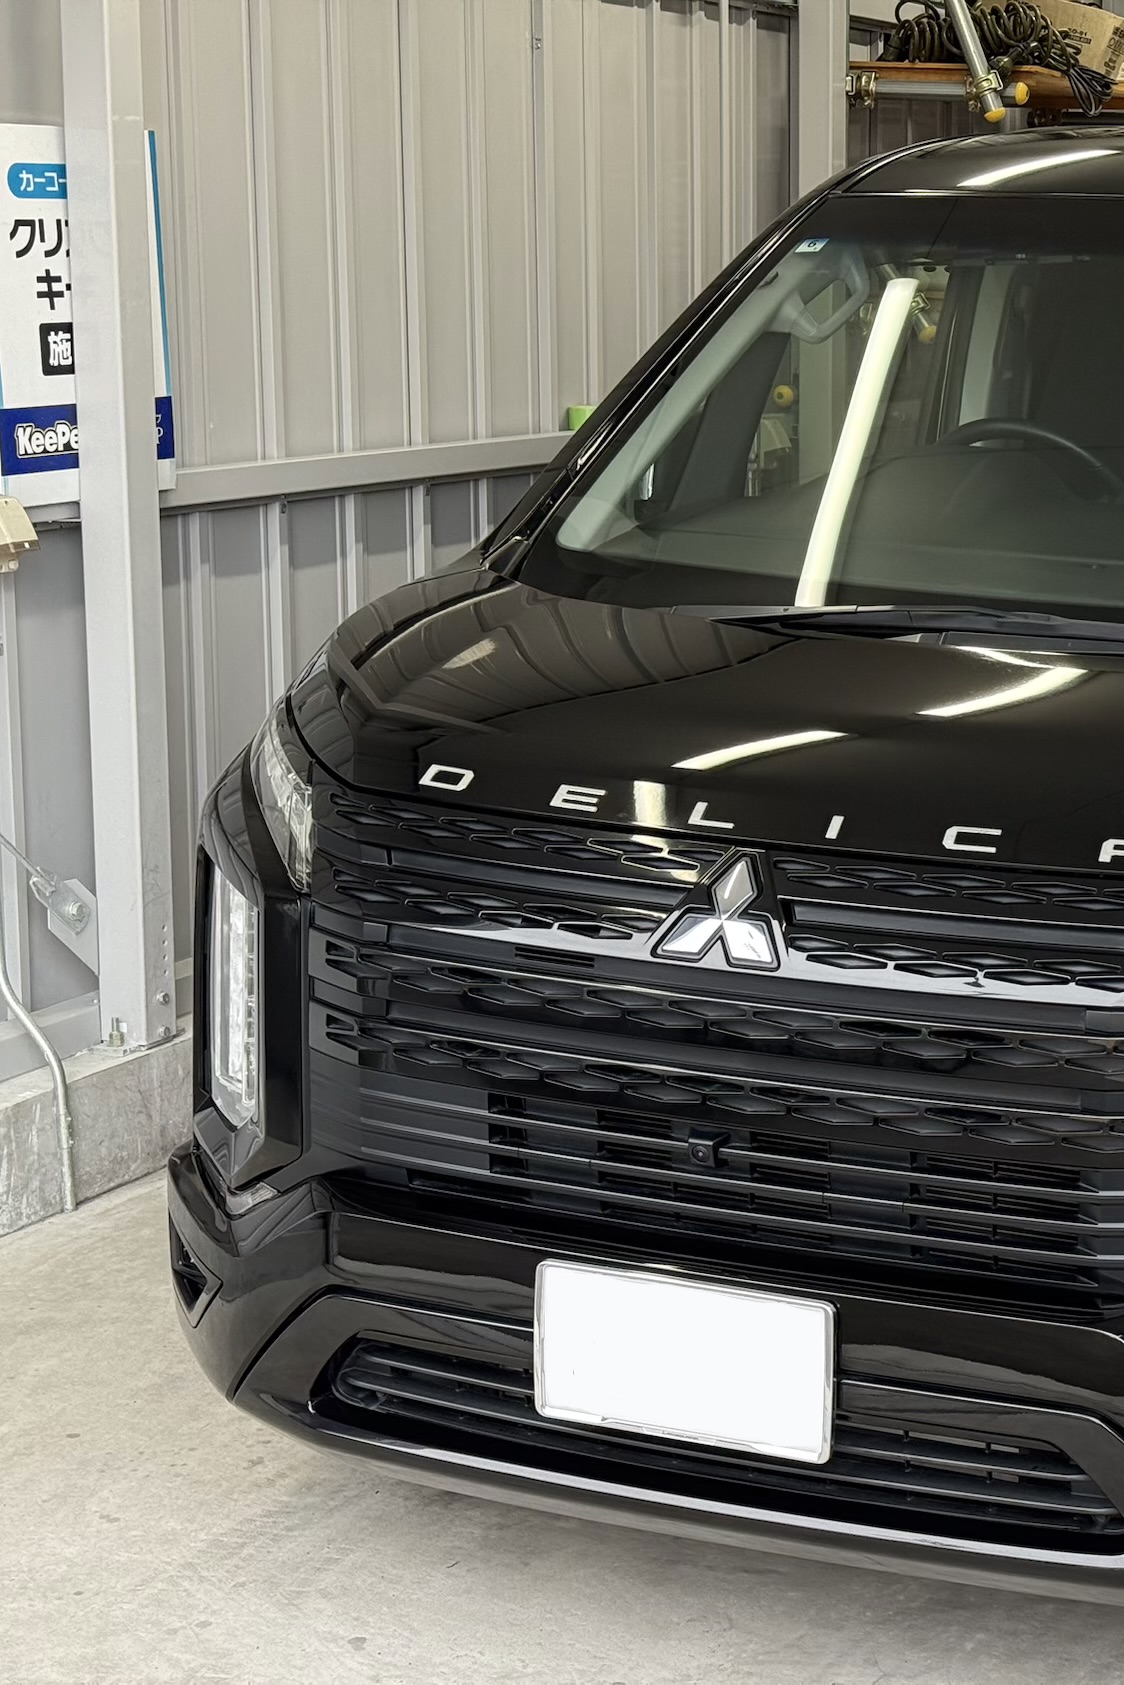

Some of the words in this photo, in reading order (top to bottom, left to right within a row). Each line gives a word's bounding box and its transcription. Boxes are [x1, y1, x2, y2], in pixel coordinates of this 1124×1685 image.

[18, 169, 67, 192] カーコー
[9, 218, 70, 258] クリ
[36, 268, 72, 311] キ
[47, 330, 73, 367] 施
